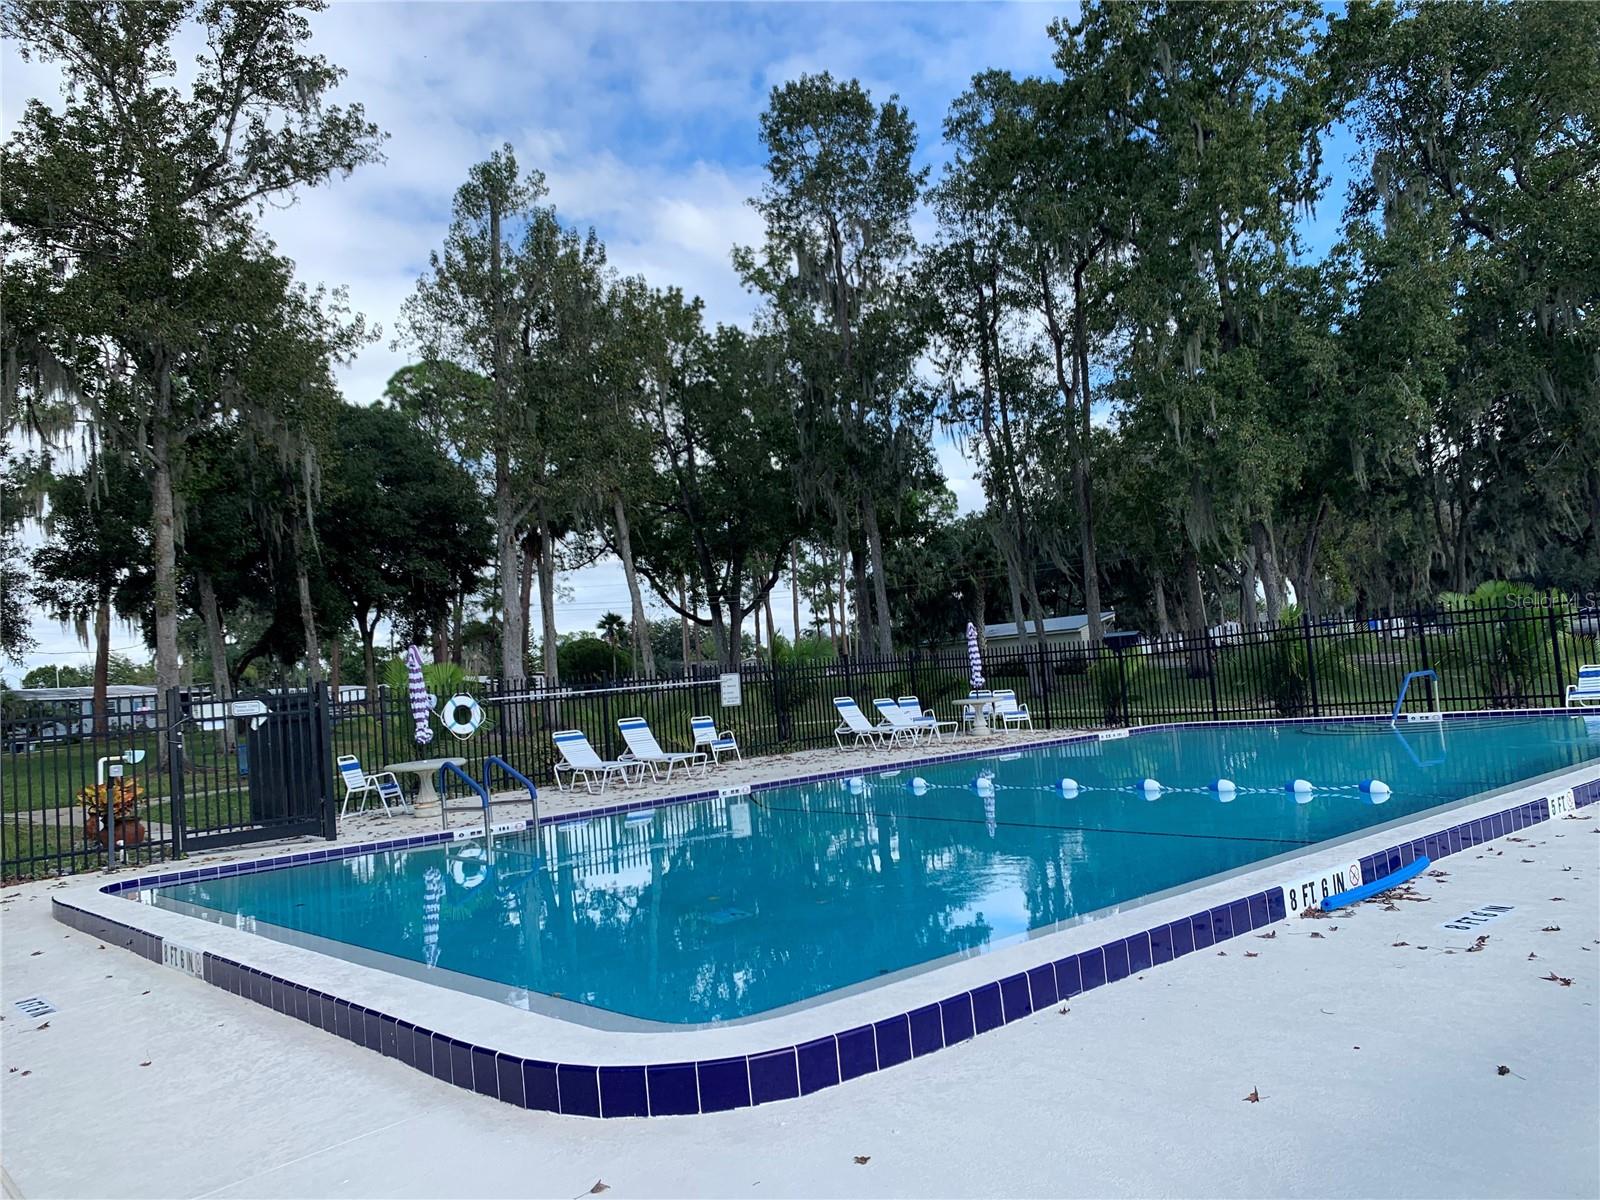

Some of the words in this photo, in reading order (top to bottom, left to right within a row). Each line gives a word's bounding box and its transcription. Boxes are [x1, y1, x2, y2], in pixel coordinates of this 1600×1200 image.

[1551, 799, 1556, 816] 5
[1289, 888, 1298, 911] 8
[1301, 880, 1318, 907] FT.
[1321, 877, 1329, 898] 6
[1332, 871, 1348, 896] IN.
[1470, 910, 1498, 918] 6
